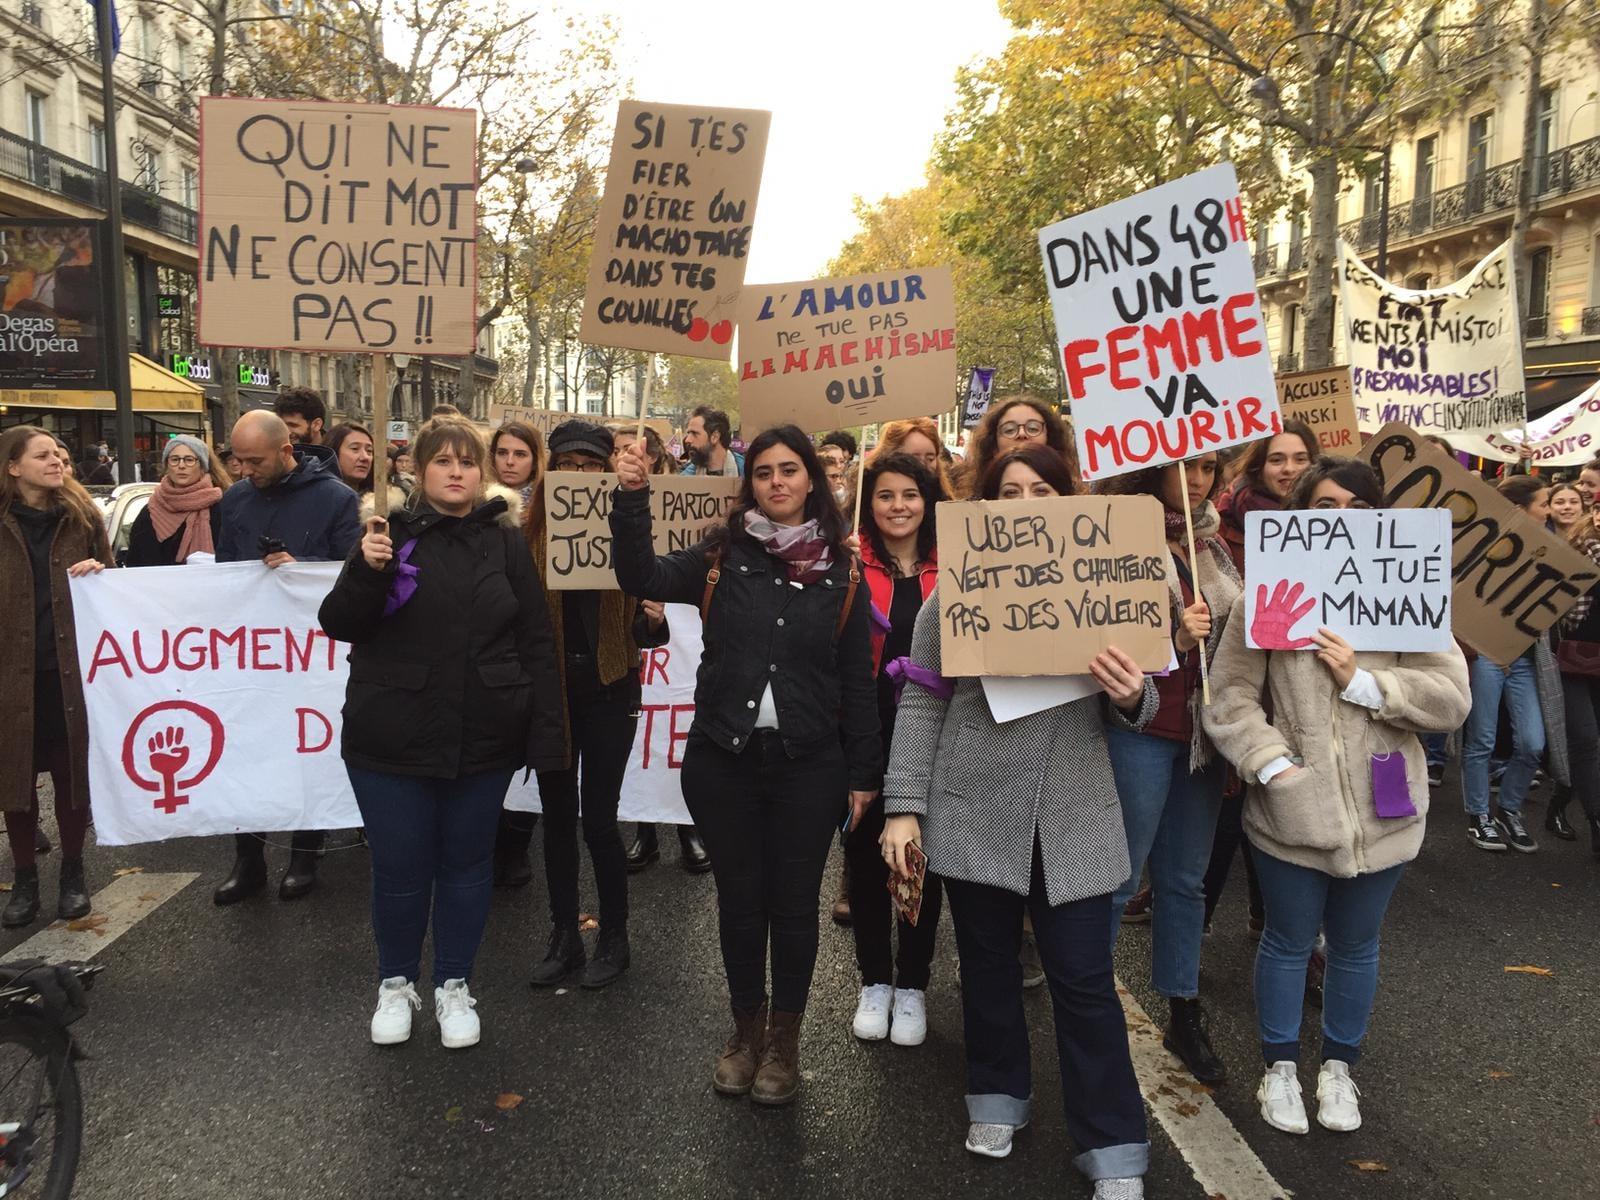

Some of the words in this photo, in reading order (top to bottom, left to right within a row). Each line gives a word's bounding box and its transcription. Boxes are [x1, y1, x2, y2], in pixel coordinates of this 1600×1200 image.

[387, 120, 450, 168] NE
[631, 112, 665, 150] SI
[632, 160, 691, 188] FIER
[385, 177, 475, 230] MOT
[708, 189, 746, 224] UN
[205, 224, 277, 282] NE
[288, 235, 475, 288] CONSENT
[616, 224, 691, 257] MACHO
[694, 225, 753, 260] TAPE
[1047, 214, 1160, 289] DANS
[1170, 196, 1247, 260] 48H
[605, 258, 663, 290] DANS
[671, 261, 716, 291] TES
[1113, 262, 1219, 324] UNE
[597, 295, 698, 335] COUILLES
[756, 274, 927, 322] L'AMOUR
[293, 293, 397, 348] PAS
[777, 328, 805, 348] ne
[869, 311, 908, 330] PAS
[9, 332, 79, 356] l'Opéra
[1063, 292, 1263, 400] FEMME
[741, 357, 775, 382] LE
[1145, 374, 1219, 418] VA
[1072, 504, 1111, 547] ON
[1259, 515, 1355, 552] PAPA
[949, 551, 1012, 593] VEUT
[1014, 560, 1064, 589] DES
[1073, 554, 1166, 587] CHAUFFEURS
[1335, 556, 1362, 585] A
[1372, 545, 1441, 583] TUÉ
[946, 602, 990, 640] PAS
[1003, 598, 1059, 632] DES
[1322, 591, 1448, 629] MAMAN
